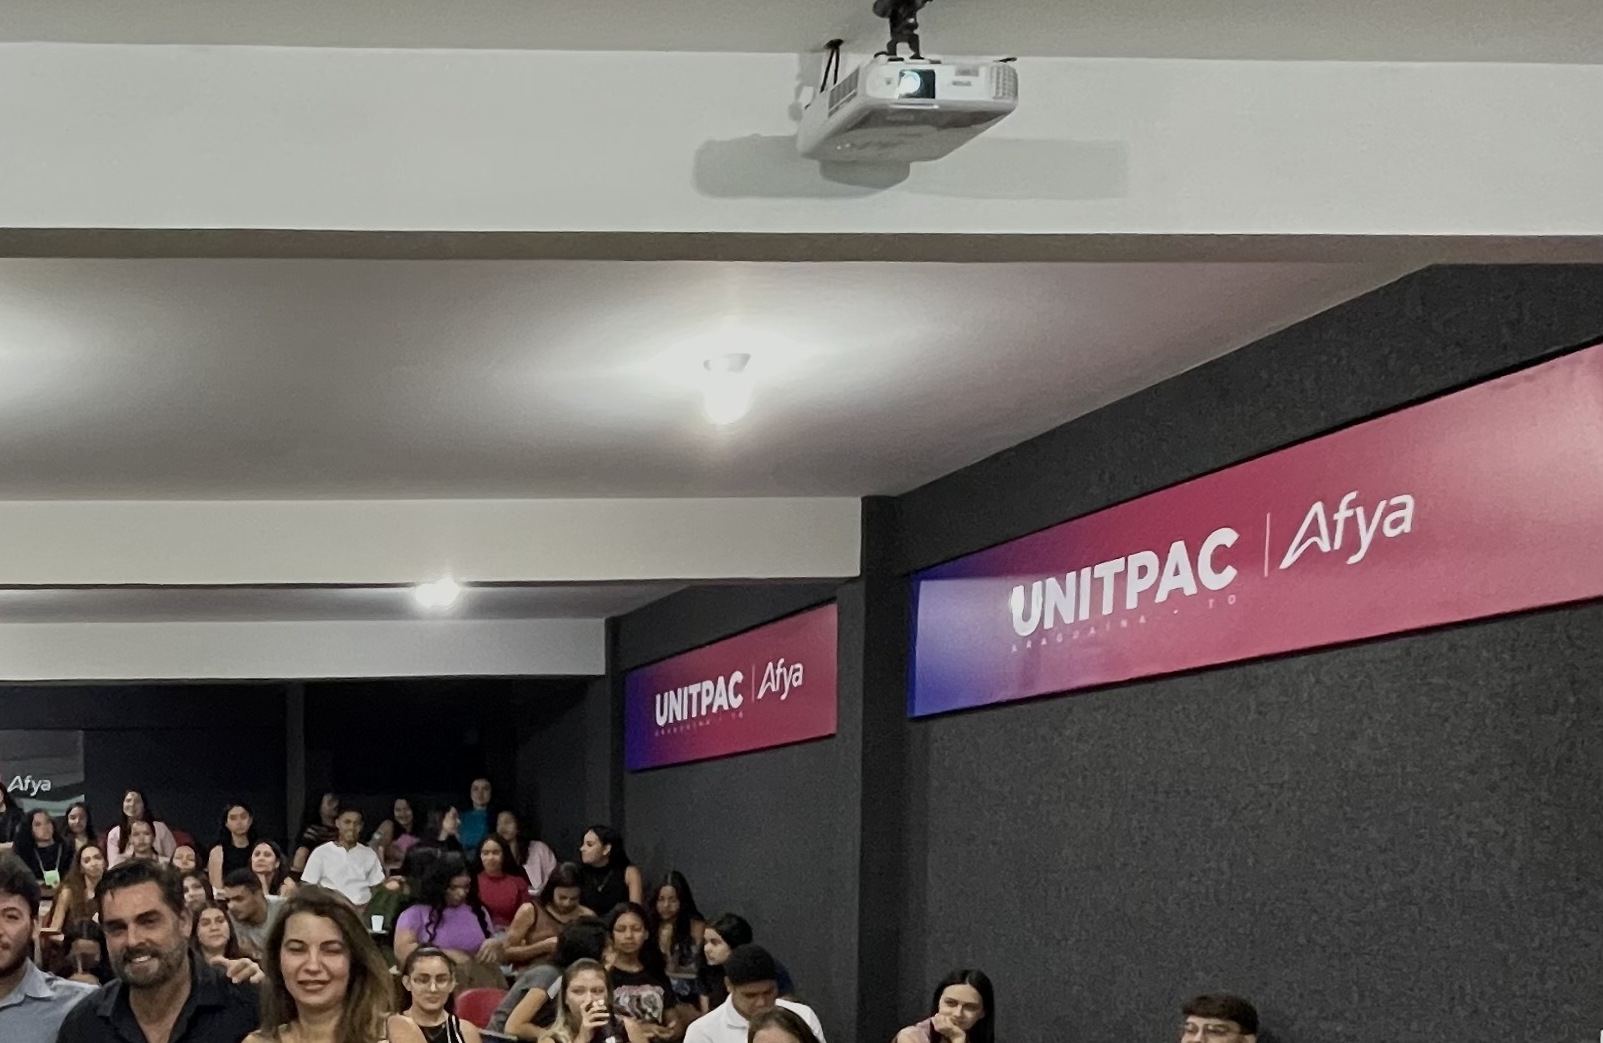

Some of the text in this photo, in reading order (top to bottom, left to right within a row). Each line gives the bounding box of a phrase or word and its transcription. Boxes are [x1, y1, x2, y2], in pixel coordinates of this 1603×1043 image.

[1009, 490, 1415, 637] UNITPAC Afya
[655, 670, 744, 727] UNITPAC
[756, 658, 805, 701] Afya
[7, 775, 52, 797] Afya
